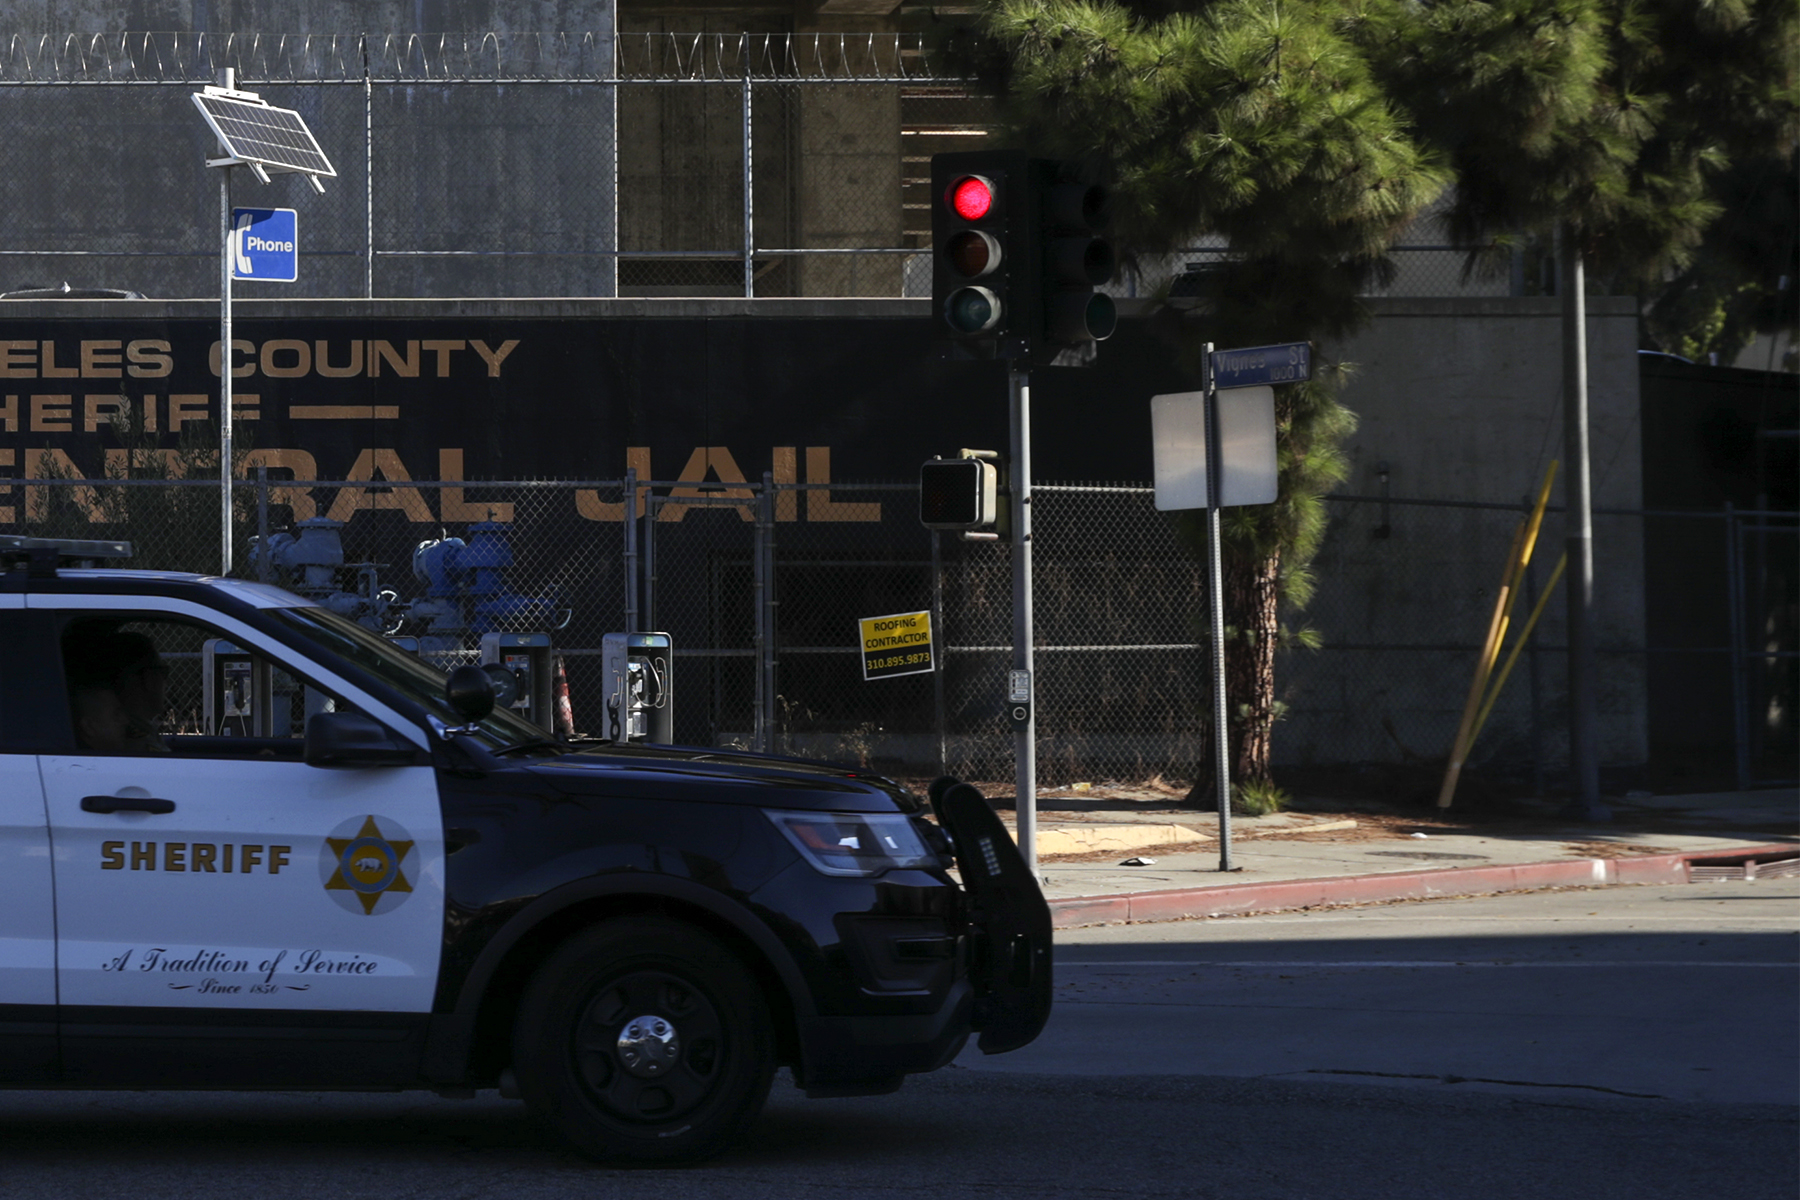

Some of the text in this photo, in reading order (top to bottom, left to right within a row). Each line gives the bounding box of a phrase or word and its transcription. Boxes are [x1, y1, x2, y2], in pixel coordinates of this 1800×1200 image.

[247, 236, 293, 253] Phone
[209, 339, 521, 378] COUNTY
[1216, 346, 1306, 377] Vignes St
[1299, 364, 1307, 377] N
[575, 446, 881, 522] JAIL
[874, 618, 916, 631] ROOFING
[865, 632, 928, 649] CONTRACTOR
[867, 652, 930, 670] 310.895.9873
[101, 841, 292, 874] SHERIFF
[102, 948, 378, 983] A Tradition of Service
[198, 978, 242, 994] Since
